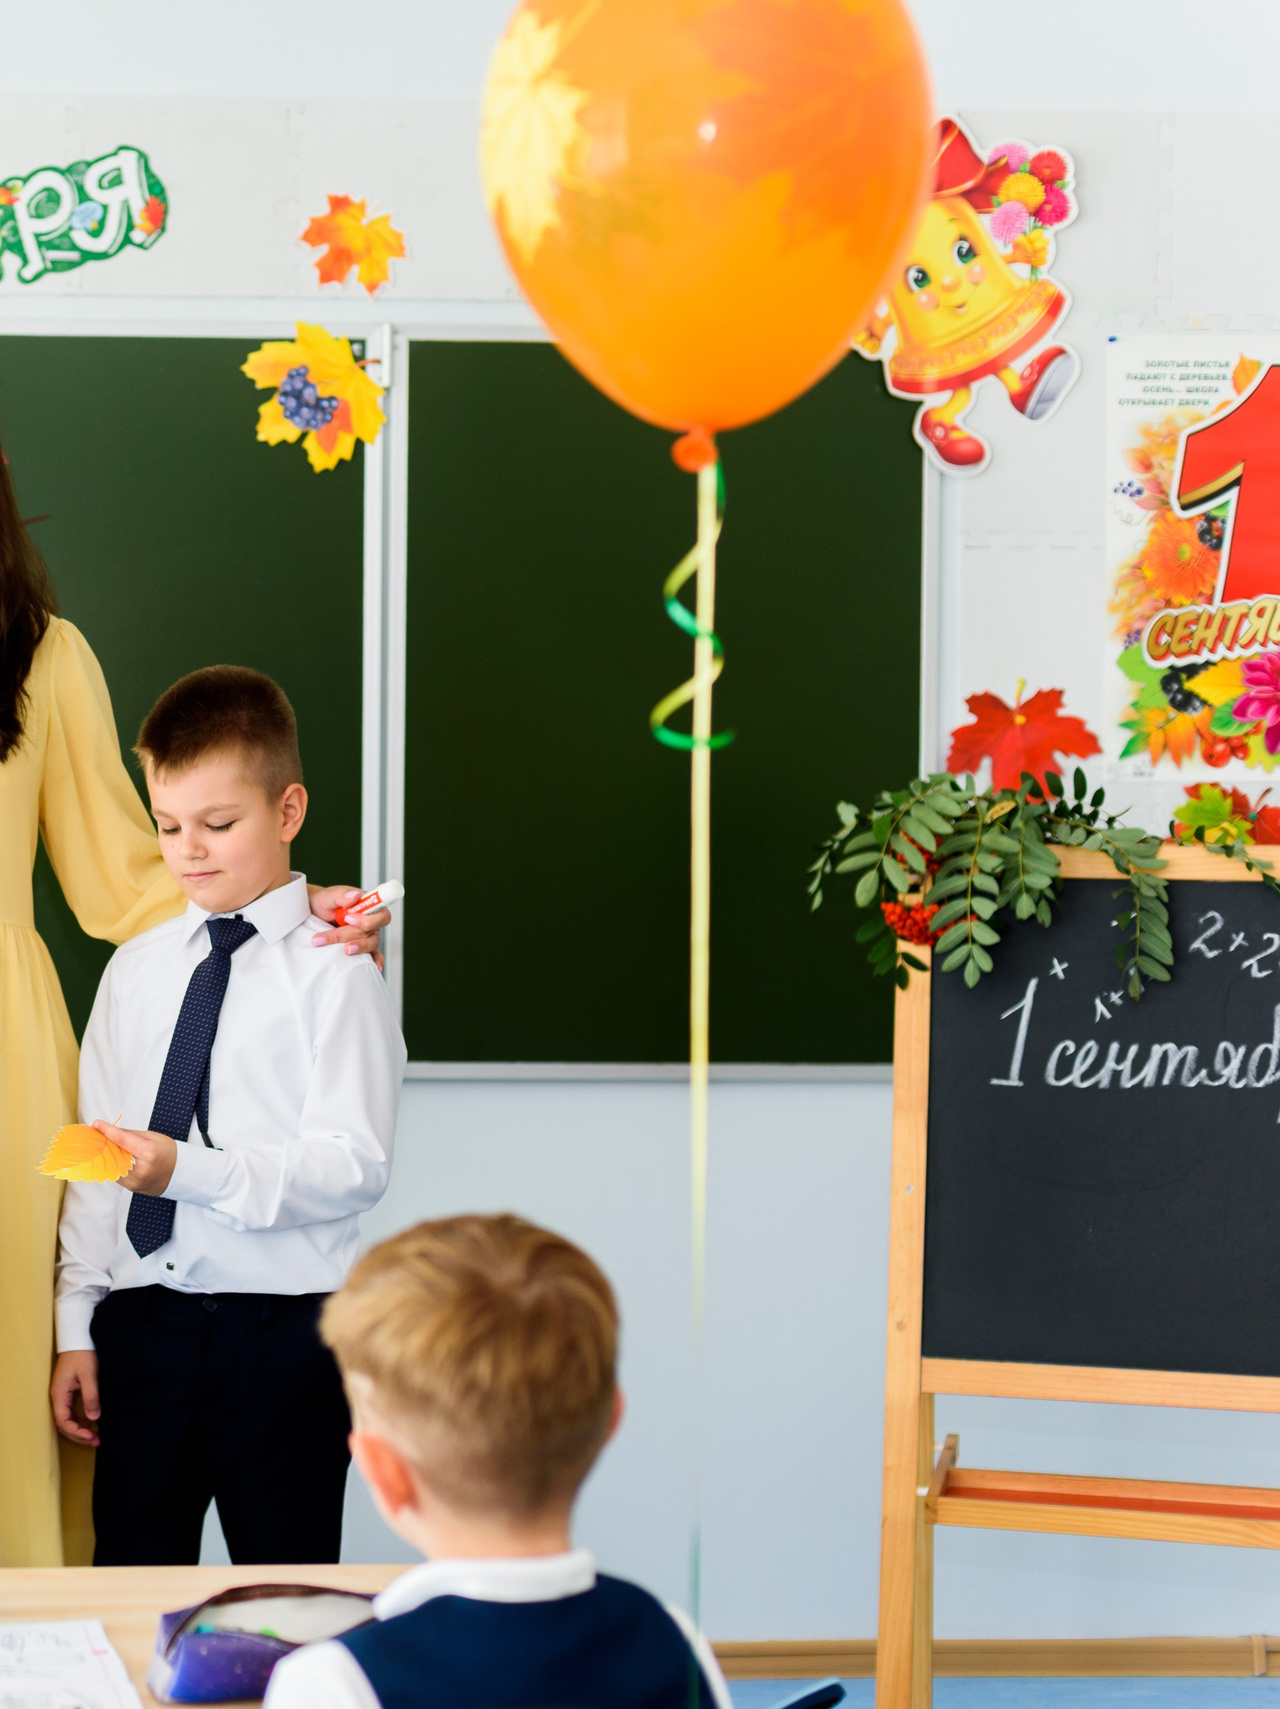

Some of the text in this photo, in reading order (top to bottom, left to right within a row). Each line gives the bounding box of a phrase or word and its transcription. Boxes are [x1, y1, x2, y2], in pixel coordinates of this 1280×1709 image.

[1145, 360, 1231, 368] ЗОЛОТЫЕ ЛИСТЬЯ
[1126, 372, 1167, 381] ПАДАЮТ
[1186, 385, 1220, 393] ШКОЛА
[1118, 398, 1175, 406] ОТКРЫВАЕТ
[989, 976, 1039, 1087] 1
